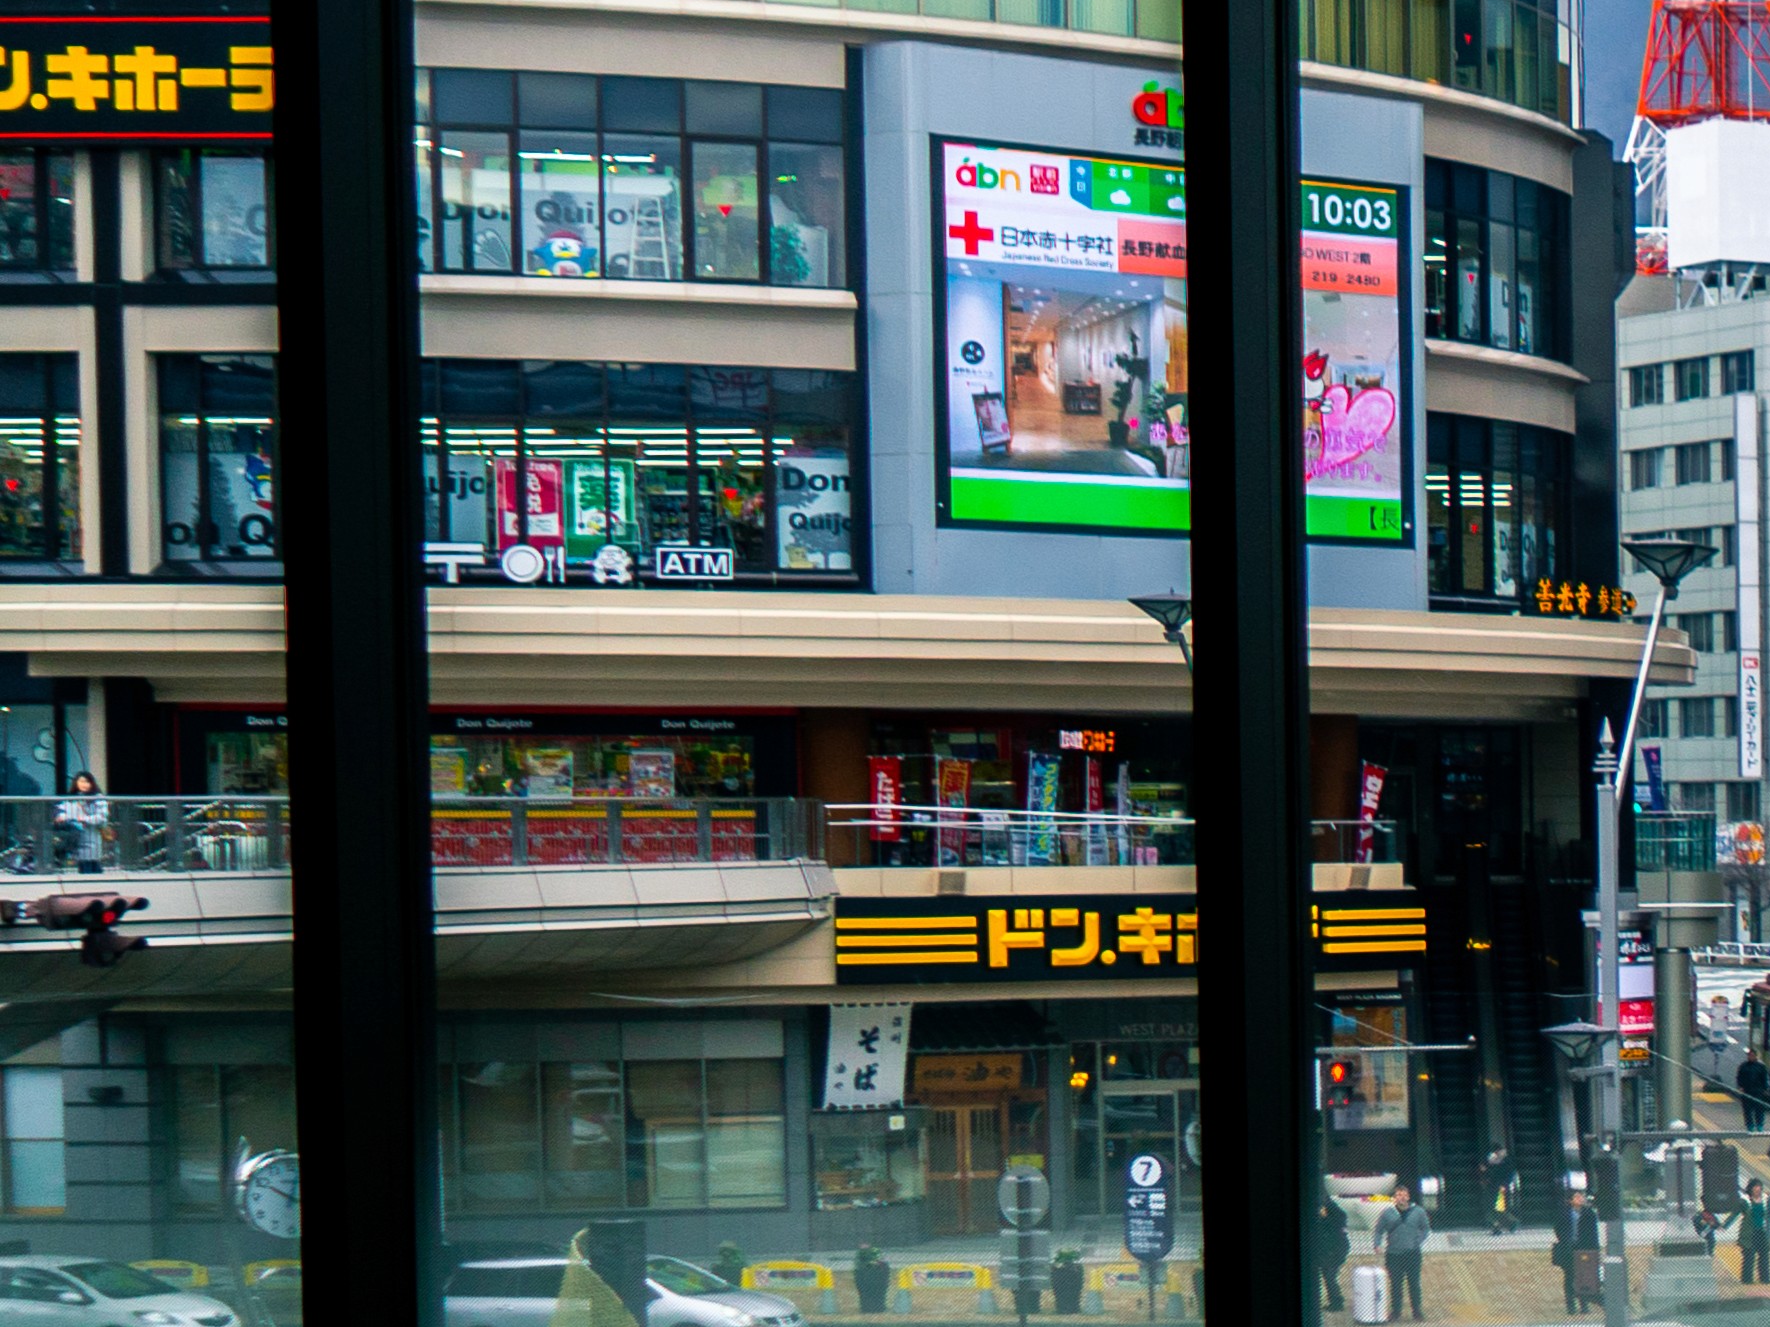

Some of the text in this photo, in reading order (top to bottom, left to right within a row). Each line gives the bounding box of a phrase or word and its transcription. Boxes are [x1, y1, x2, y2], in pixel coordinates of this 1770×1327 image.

[1308, 193, 1391, 230] 10:03
[1002, 226, 1114, 256] 日本赤十字社
[663, 552, 729, 576] ATM
[1139, 1160, 1152, 1182] 7
